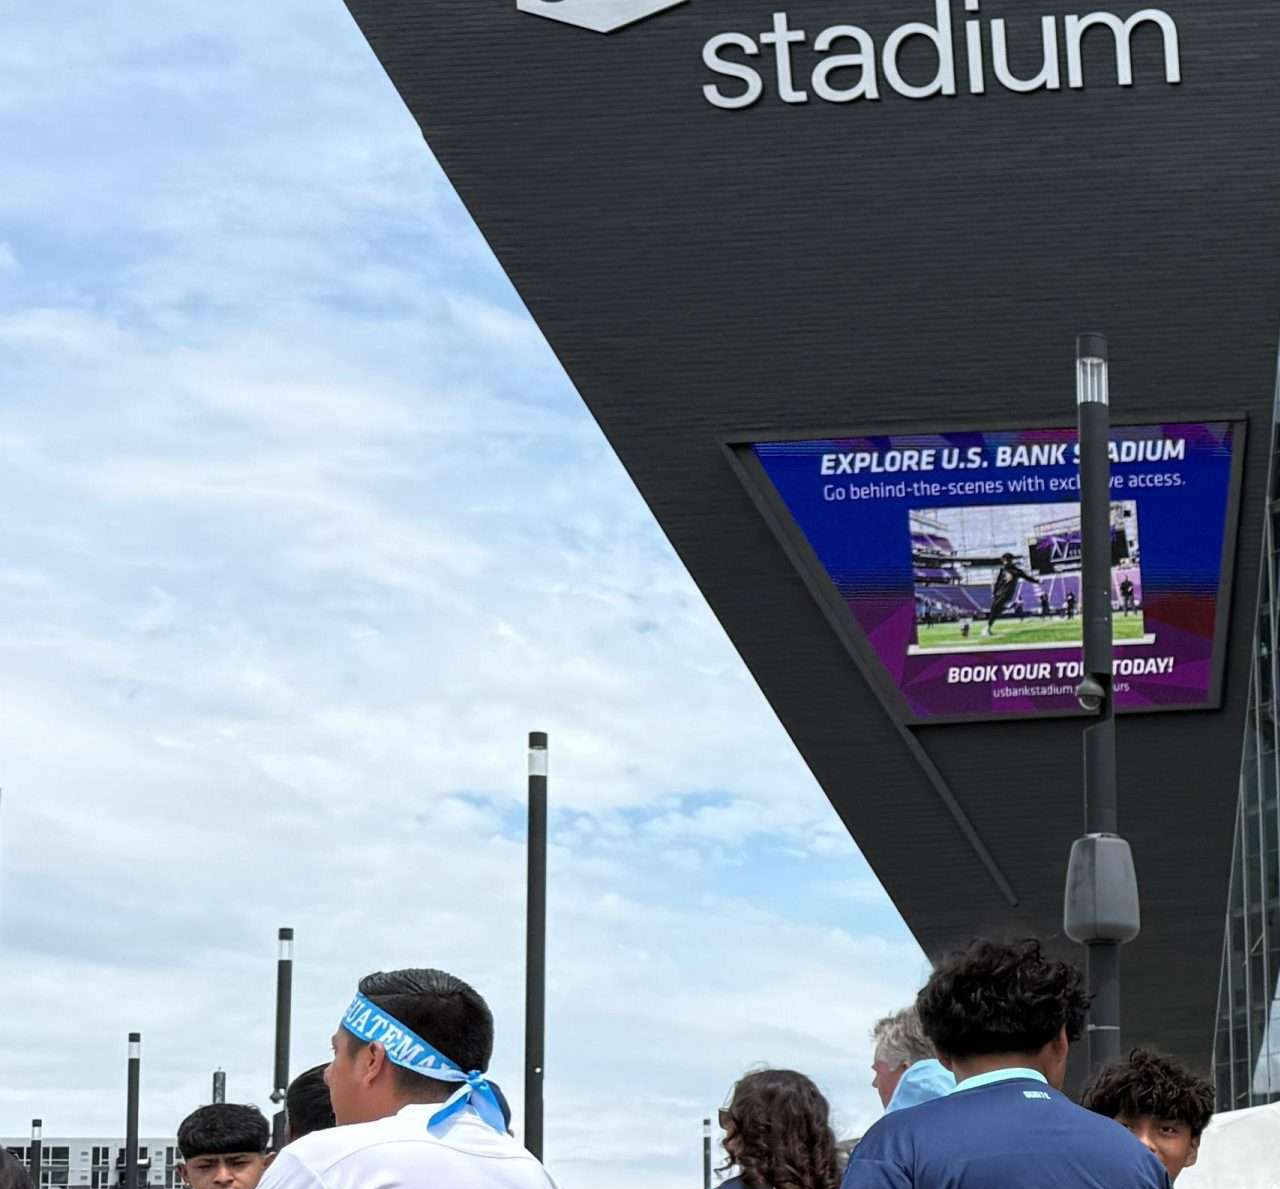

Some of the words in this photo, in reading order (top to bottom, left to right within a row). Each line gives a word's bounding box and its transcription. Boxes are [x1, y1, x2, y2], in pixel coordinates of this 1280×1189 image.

[702, 0, 1182, 109] stadium
[820, 450, 936, 475] EXPLORE
[941, 447, 988, 470] U.S.
[995, 443, 1068, 468] BANK
[1072, 438, 1186, 464] SADIUM
[823, 484, 846, 501] Go
[850, 479, 1004, 500] behind-the-scenes
[1008, 475, 1045, 492] with
[1128, 472, 1187, 488] access.
[947, 665, 999, 683] BOOK
[1001, 663, 1051, 681] YOUR
[1111, 656, 1175, 676] TODAY!
